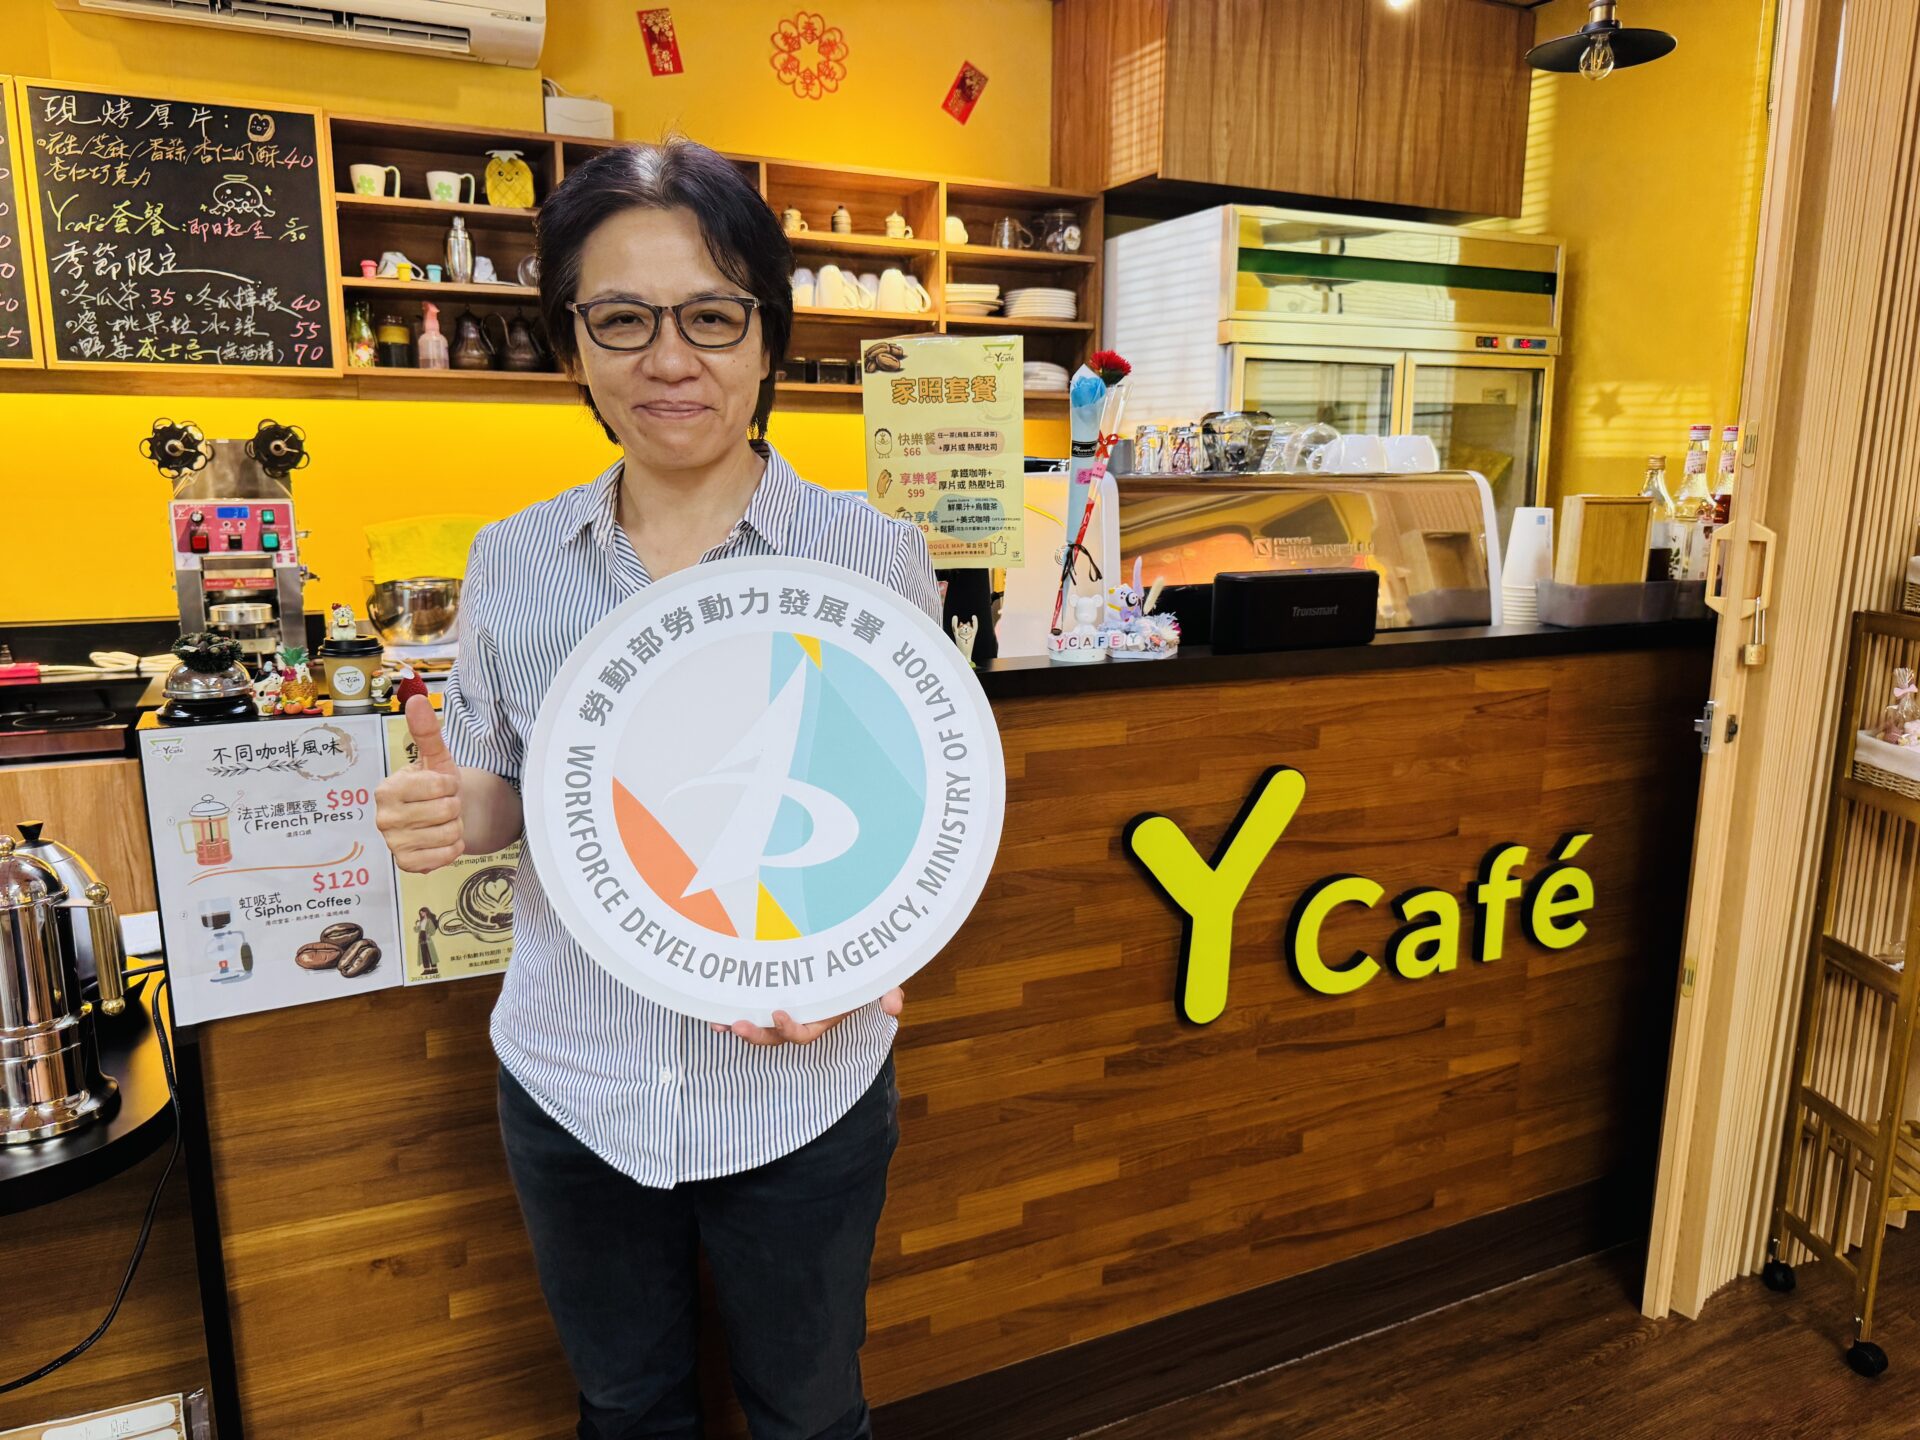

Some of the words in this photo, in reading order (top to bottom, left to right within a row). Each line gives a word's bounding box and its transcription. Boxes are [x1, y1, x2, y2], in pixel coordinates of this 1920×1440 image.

[284, 146, 314, 170] 40
[44, 156, 151, 188] 杏仁巧克力
[188, 217, 273, 242] 即日起至
[150, 288, 176, 306] 35
[291, 295, 321, 312] 40
[290, 321, 321, 339] 55
[294, 343, 323, 365] 70
[890, 375, 997, 405] 家照套餐
[898, 432, 936, 446] 快樂餐
[904, 447, 921, 457] $66
[900, 472, 937, 485] 享樂餐
[907, 488, 925, 498] $99
[1274, 536, 1311, 545] nuova
[1292, 605, 1339, 617] Tronsmart
[578, 586, 886, 727] 勞動部勞動力發展署
[892, 641, 957, 724] LABOR
[212, 738, 344, 764] 不同咖啡風味
[938, 729, 968, 761] OF
[237, 800, 318, 821] 法式濾壓壺
[326, 788, 369, 810] $90
[564, 744, 629, 914] WORKFORCE
[916, 771, 971, 897] MINISTRY
[312, 868, 370, 893] $120
[238, 892, 282, 910] 虹吸式
[619, 906, 816, 988] DEVELOPMENT
[826, 895, 930, 977] AGENCY,
